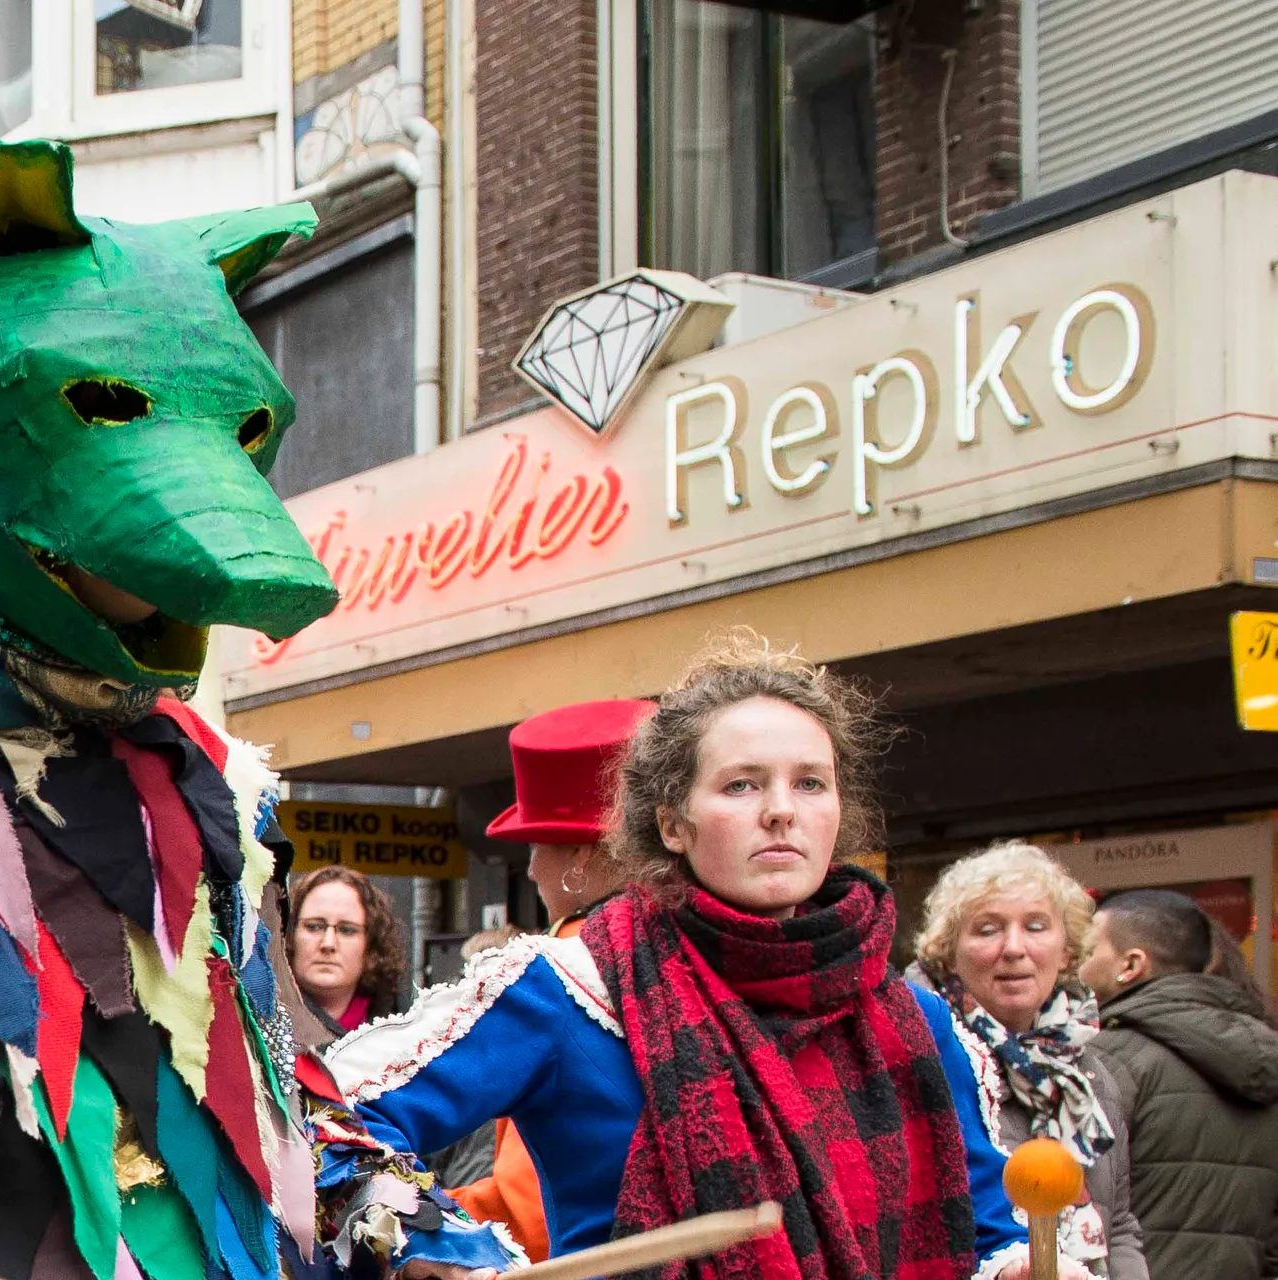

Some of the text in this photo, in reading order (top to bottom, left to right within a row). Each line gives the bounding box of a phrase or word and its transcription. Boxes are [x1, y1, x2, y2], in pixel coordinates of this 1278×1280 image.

[664, 282, 1157, 530] Repko
[295, 809, 459, 842] SEIKO koop
[308, 839, 449, 867] bij REPKO
[1094, 840, 1181, 864] PANDORA
